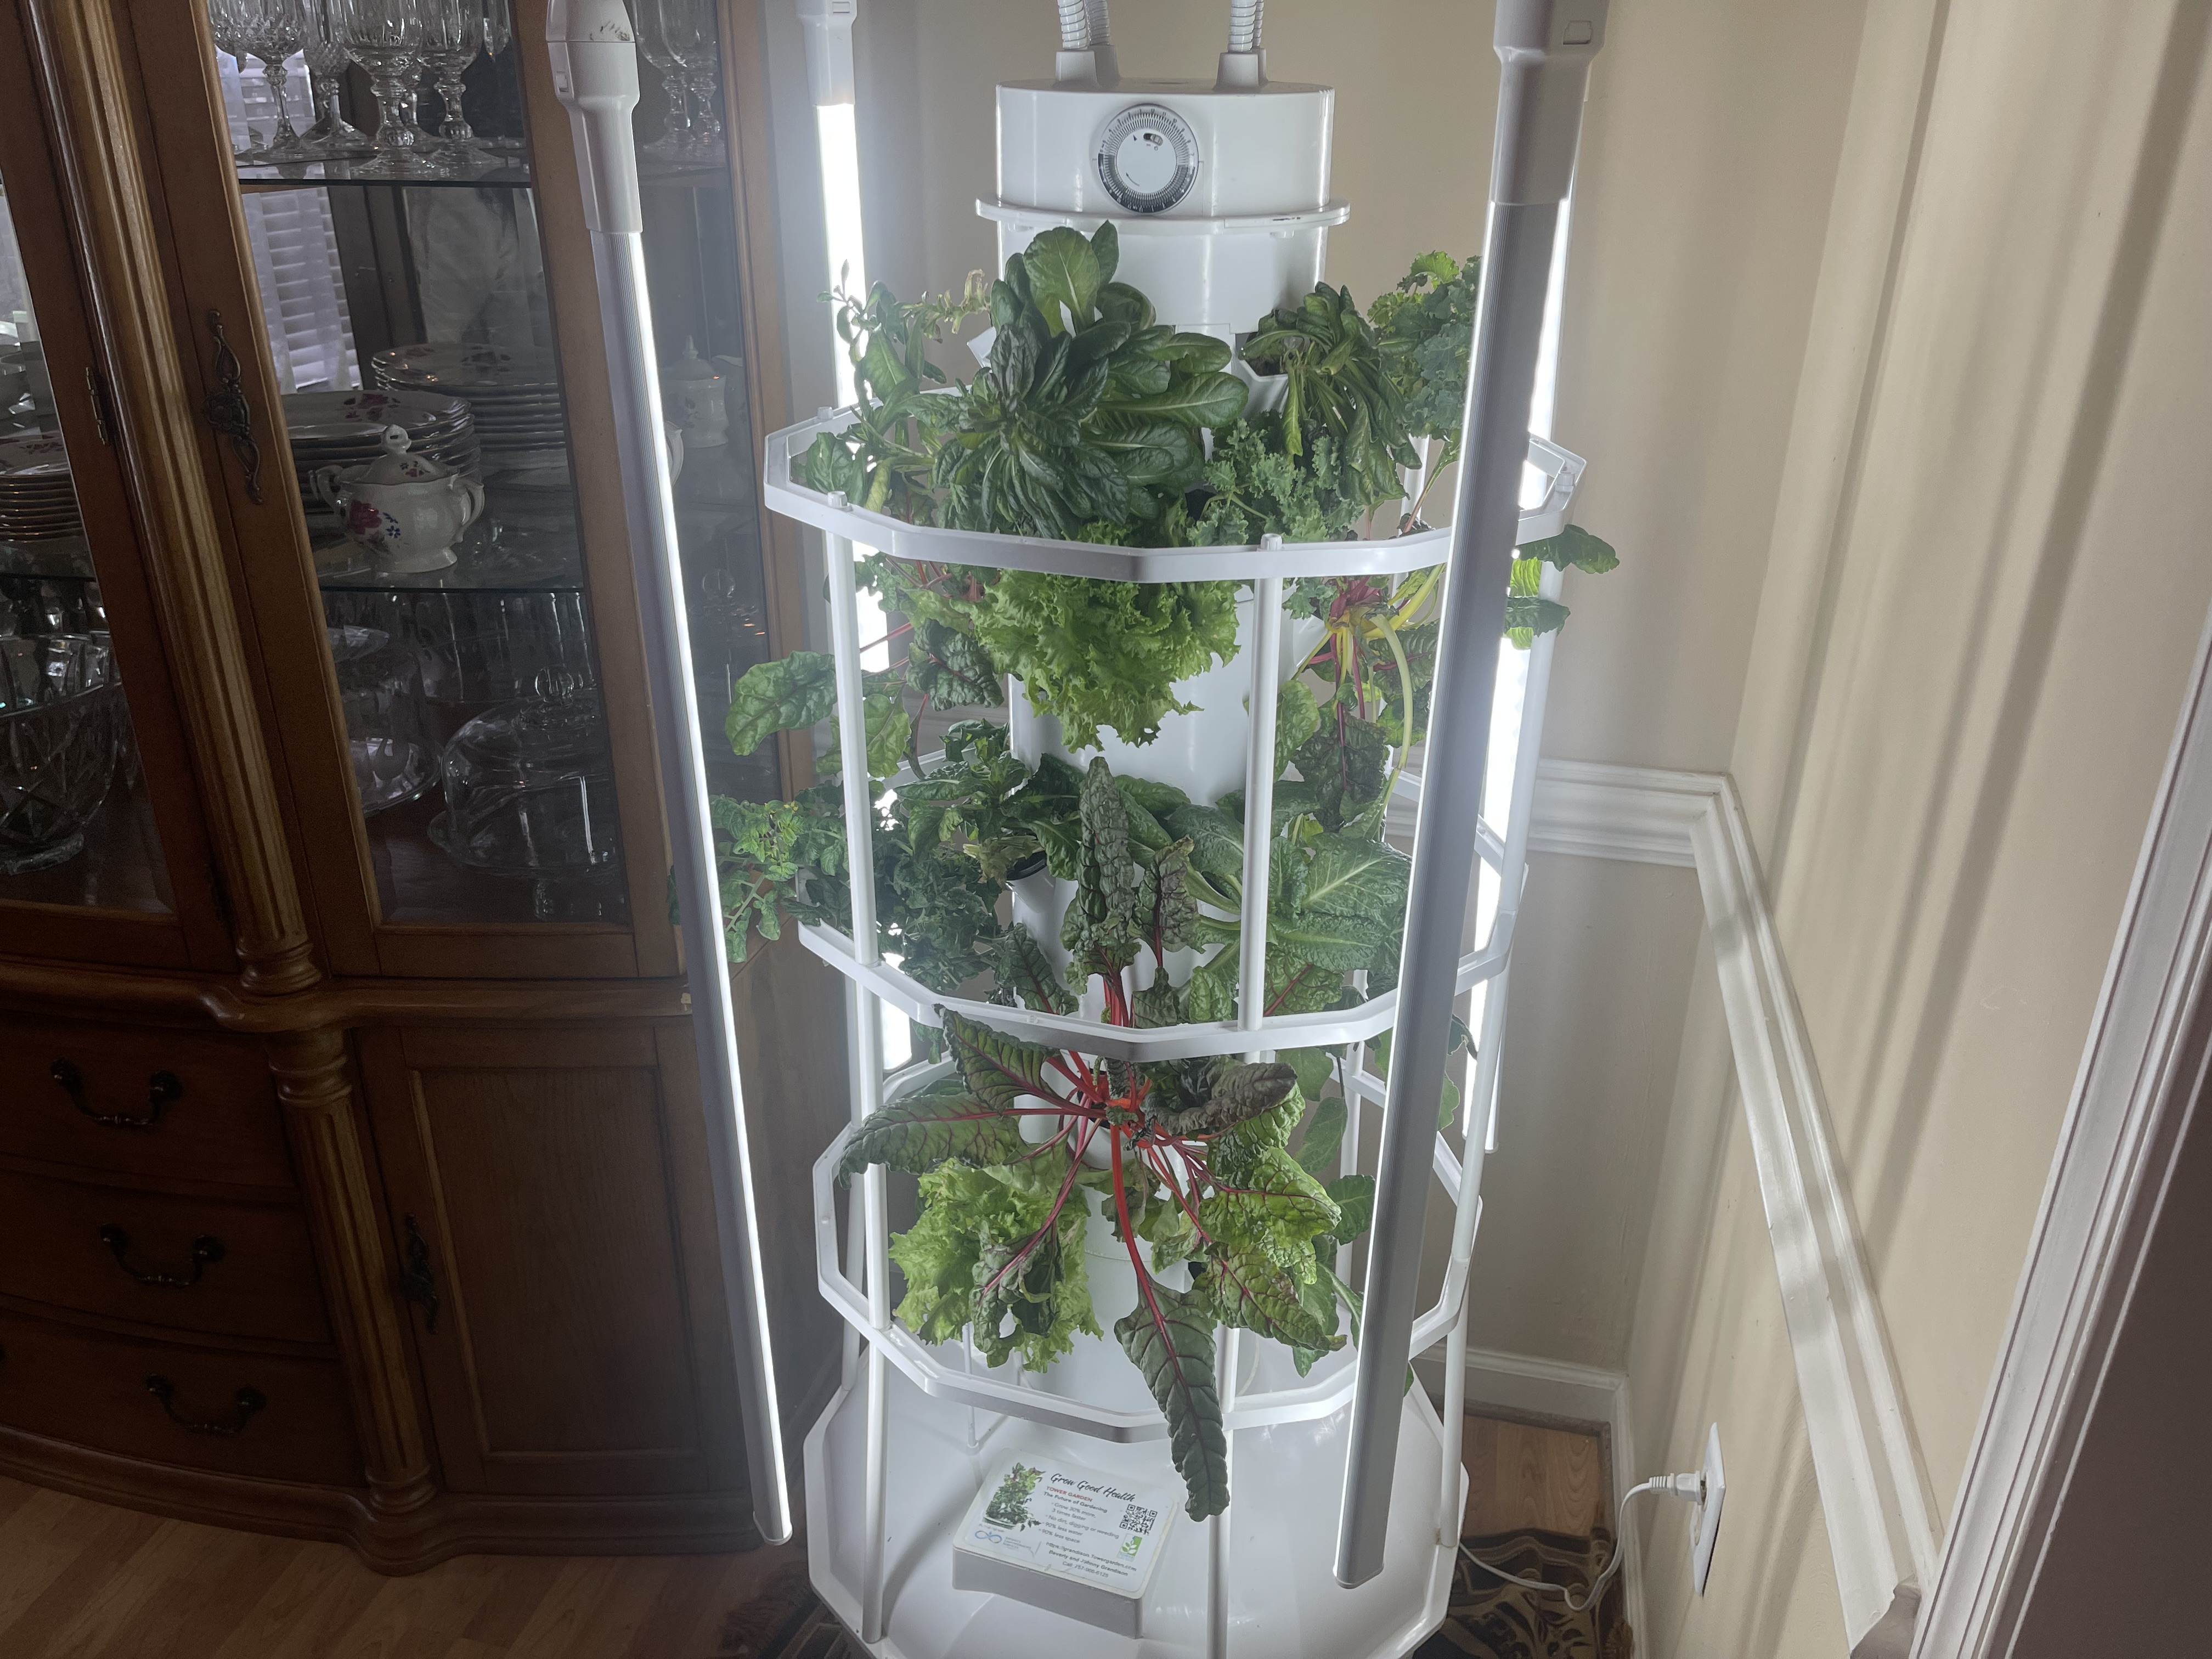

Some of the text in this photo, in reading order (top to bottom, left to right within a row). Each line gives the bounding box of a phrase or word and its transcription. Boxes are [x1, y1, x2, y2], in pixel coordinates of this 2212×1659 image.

[1046, 1486, 1093, 1502] TOWER GARDEN
[1051, 1473, 1136, 1503] Grow Good Health
[1054, 1494, 1072, 1503] Future
[1080, 1502, 1108, 1514] Gardening
[1069, 1521, 1090, 1531] digging
[1097, 1530, 1119, 1539] weeding
[1048, 1550, 1068, 1560] Beverly
[1080, 1559, 1099, 1568] Johnny
[1101, 1565, 1128, 1576] Grandison
